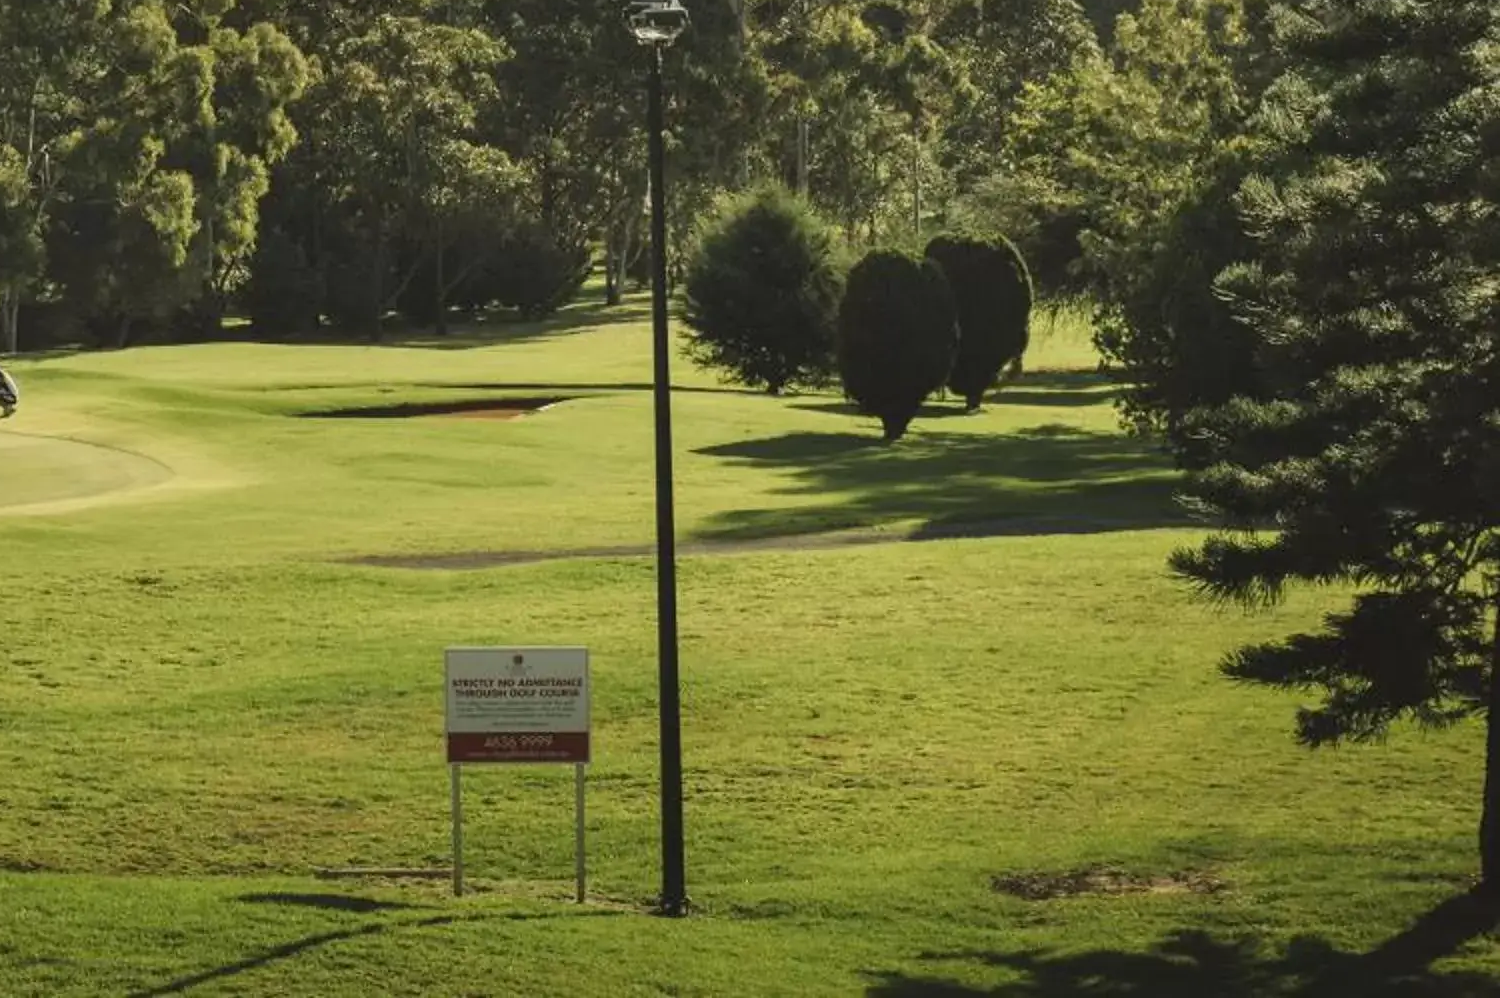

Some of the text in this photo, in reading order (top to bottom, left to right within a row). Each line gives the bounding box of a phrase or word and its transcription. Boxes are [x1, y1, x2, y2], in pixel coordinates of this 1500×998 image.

[452, 677, 582, 687] STRICTLY NO ADMITTANCE
[455, 689, 580, 698] THROUGH GOLF COURSE
